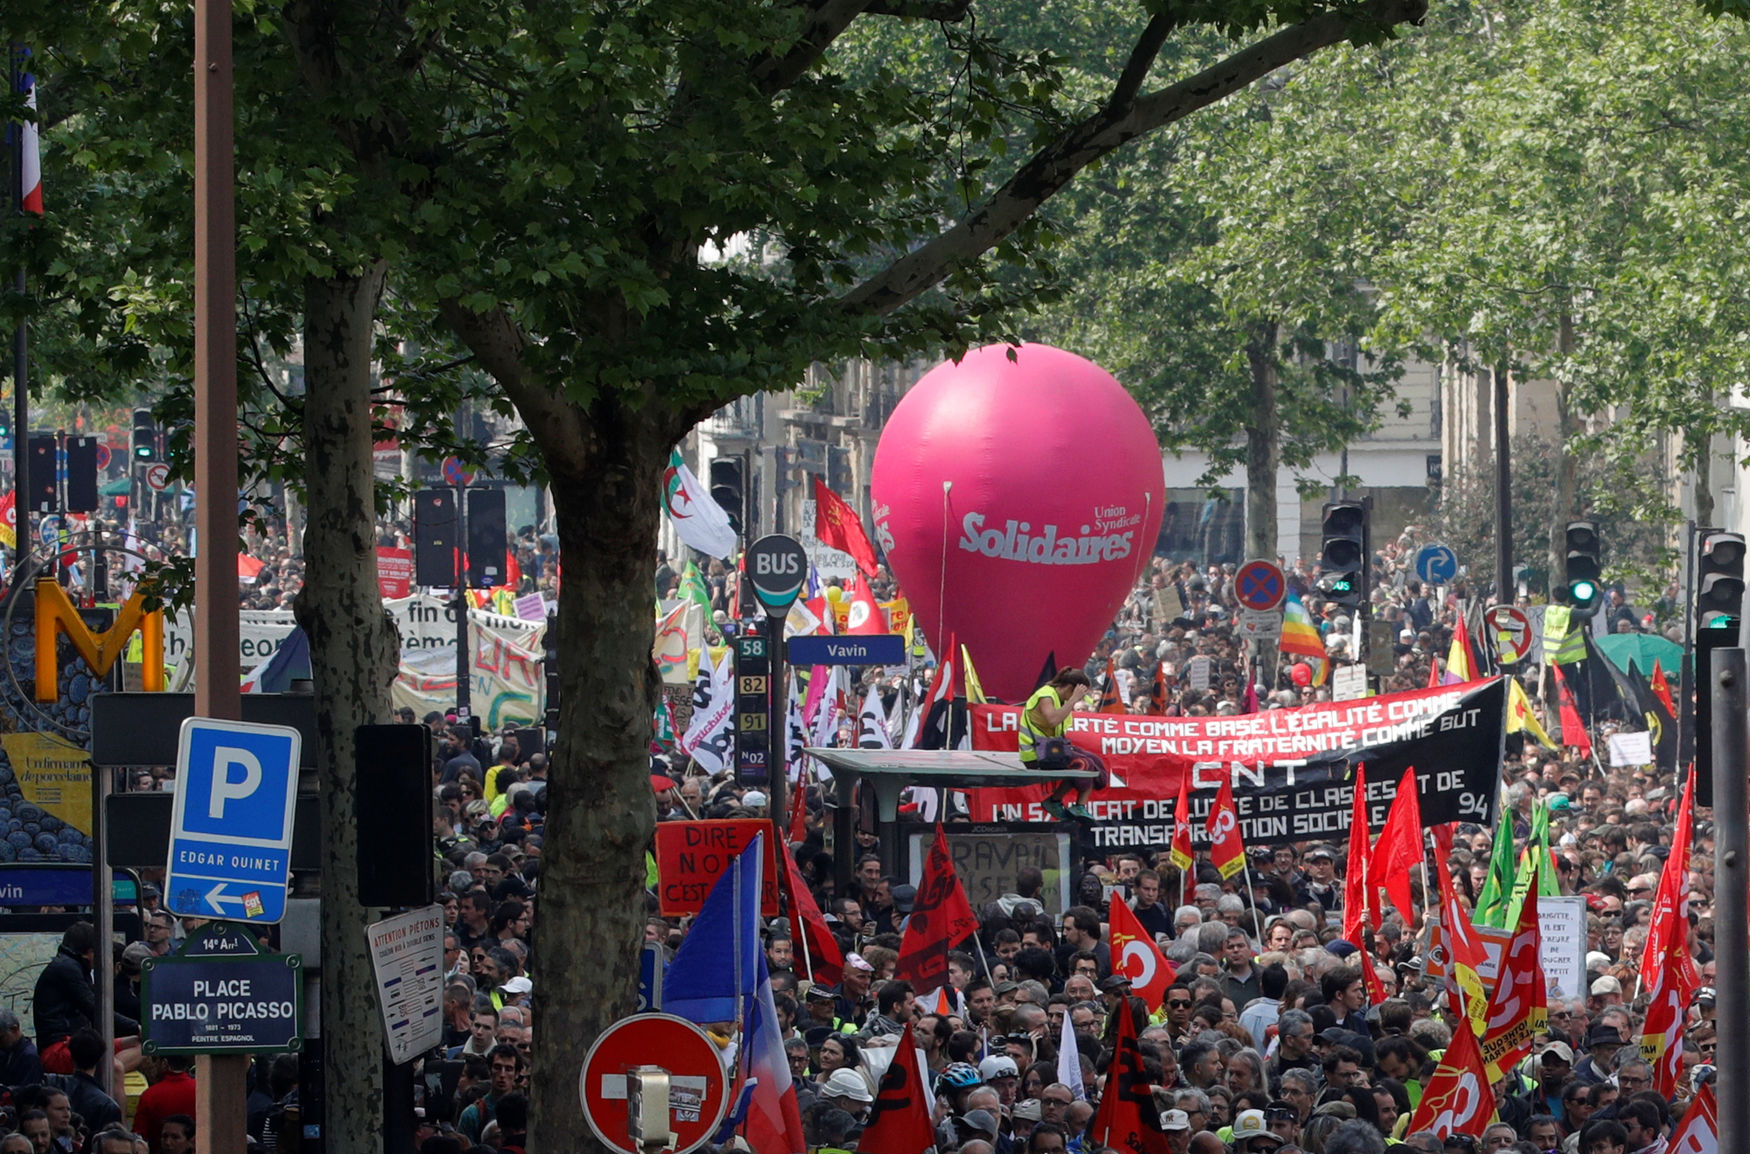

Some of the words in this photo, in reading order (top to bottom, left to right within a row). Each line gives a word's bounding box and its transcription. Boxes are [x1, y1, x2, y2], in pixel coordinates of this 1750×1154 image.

[1095, 505, 1127, 519] Union
[959, 511, 1134, 566] Solidaires
[757, 552, 799, 575] BUS
[743, 640, 763, 656] 58
[827, 643, 868, 658] Vavin
[743, 677, 763, 693] 82
[744, 714, 763, 730] 91
[986, 712, 1018, 733] LA
[1124, 720, 1200, 738] COMME
[1387, 690, 1463, 721] COMME
[1182, 739, 1214, 756] LA
[1218, 729, 1358, 756] FRATERNITÉ
[1361, 719, 1434, 747] COMME
[1439, 707, 1482, 733] BUT
[208, 745, 263, 820] P
[992, 802, 1023, 823] UN
[1143, 799, 1174, 820] DE
[1259, 794, 1289, 812] DE
[1295, 779, 1397, 809] CLASES
[1436, 769, 1466, 792] DE
[1458, 791, 1489, 822] 94
[685, 826, 739, 849] DIRE
[180, 850, 226, 867] EDGAR
[231, 855, 280, 872] QUINET
[374, 926, 407, 948] ATTENTION
[409, 916, 440, 935] PIÉTONS
[193, 979, 251, 998] PLACE
[152, 1002, 209, 1020] PABLO
[216, 1001, 294, 1020] PICASSO
[192, 1035, 219, 1043] PEINTRE
[221, 1034, 255, 1043] ESPAGNOL
